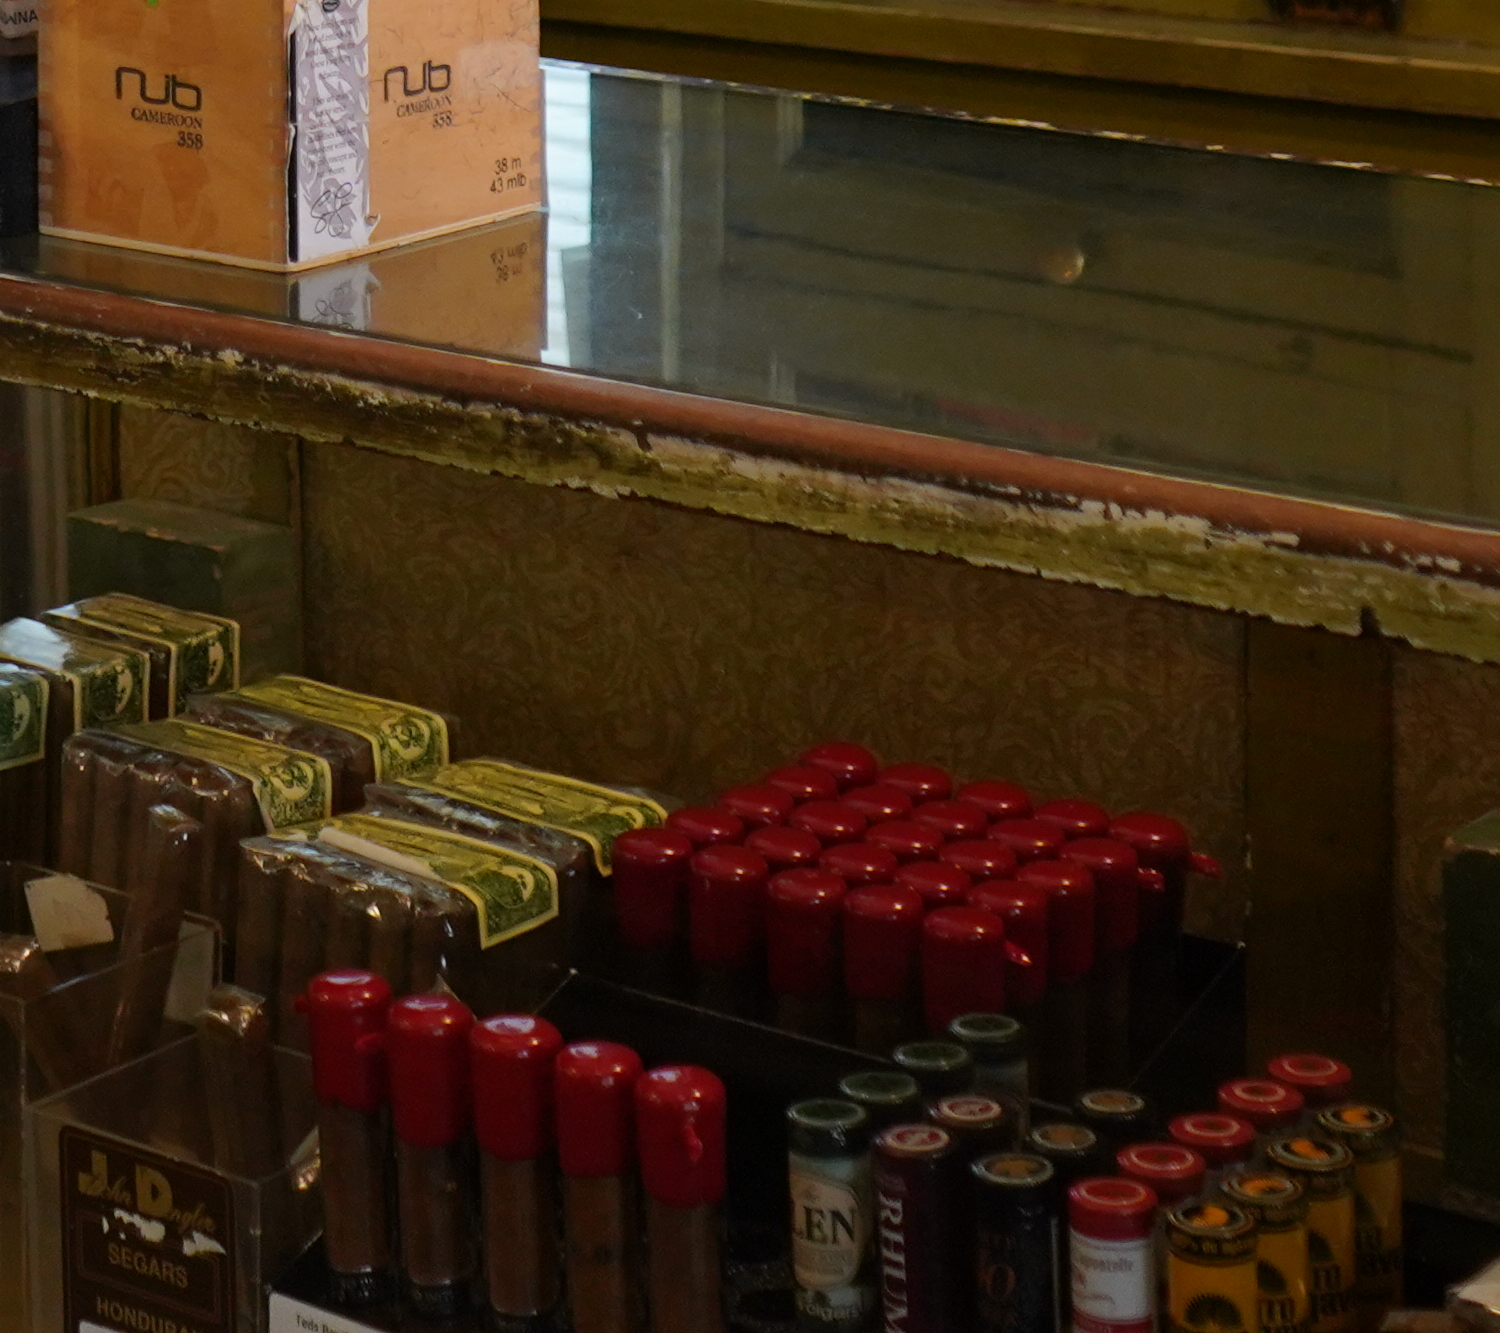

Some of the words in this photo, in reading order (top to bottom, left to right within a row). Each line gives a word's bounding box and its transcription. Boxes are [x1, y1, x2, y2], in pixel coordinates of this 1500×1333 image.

[115, 66, 203, 112] nub
[383, 59, 451, 102] nub
[396, 94, 453, 118] CAMEROON
[130, 107, 203, 130] CAMEROON
[177, 129, 204, 151] 358
[494, 157, 509, 176] 38
[511, 156, 523, 170] m
[489, 176, 504, 194] 43
[76, 1148, 133, 1208] John
[134, 1162, 218, 1235] Dengler
[106, 1241, 190, 1290] SEGARS
